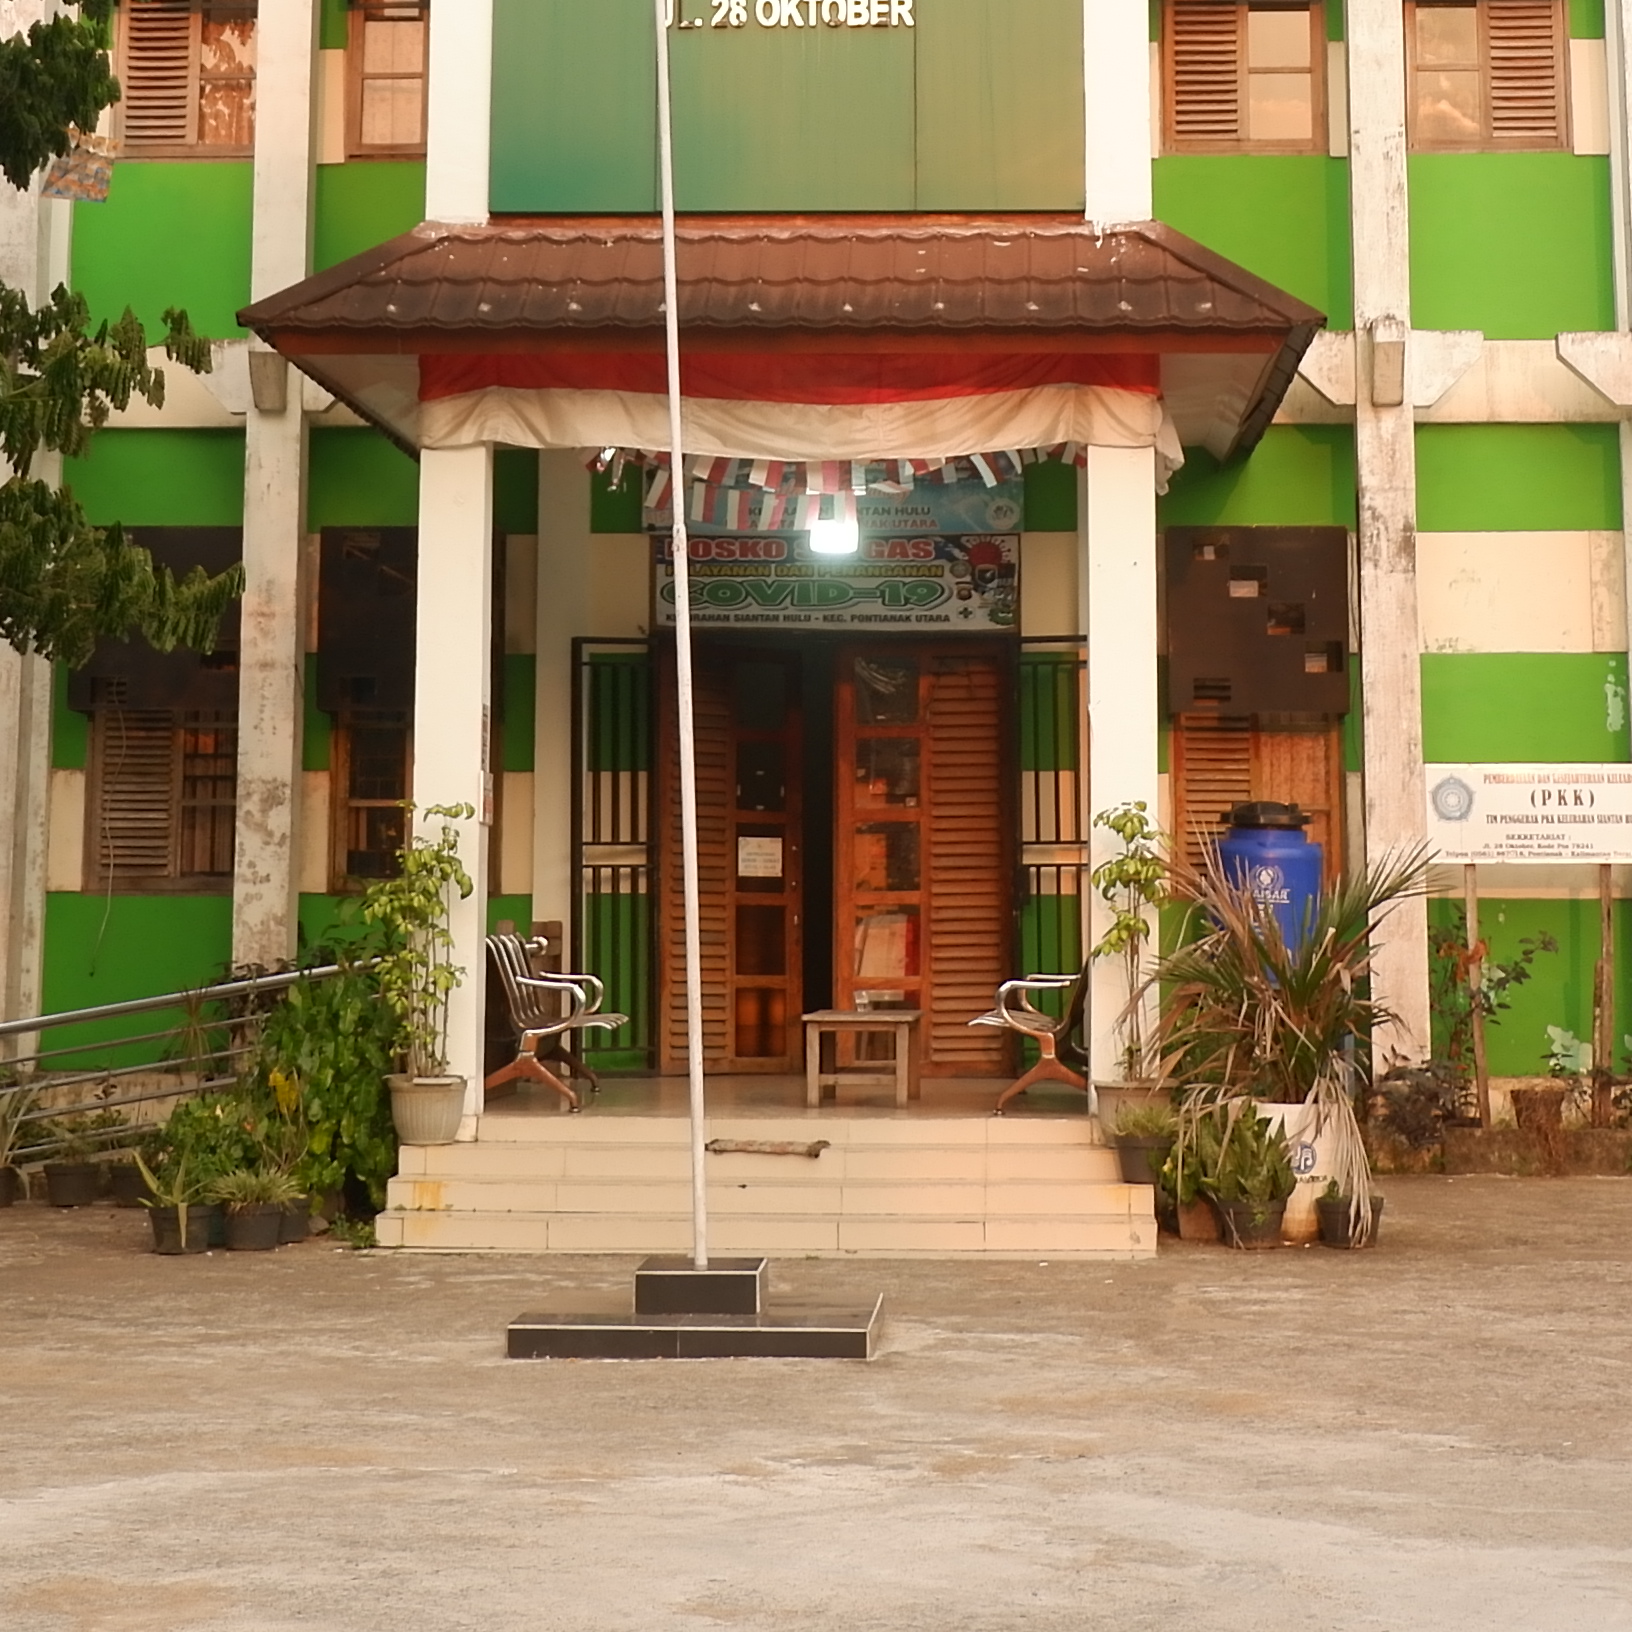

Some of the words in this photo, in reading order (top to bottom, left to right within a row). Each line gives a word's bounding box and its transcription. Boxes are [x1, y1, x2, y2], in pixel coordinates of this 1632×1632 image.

[895, 506, 931, 516] HULU
[775, 565, 814, 578] DAN
[818, 565, 945, 578] PENANGANAN
[660, 578, 949, 610] COVID-19
[733, 613, 782, 622] SIANTAN
[783, 613, 811, 622] HULU
[850, 614, 912, 623] PONTIANAK
[915, 614, 951, 623] UTARA
[1540, 814, 1555, 824] PKK
